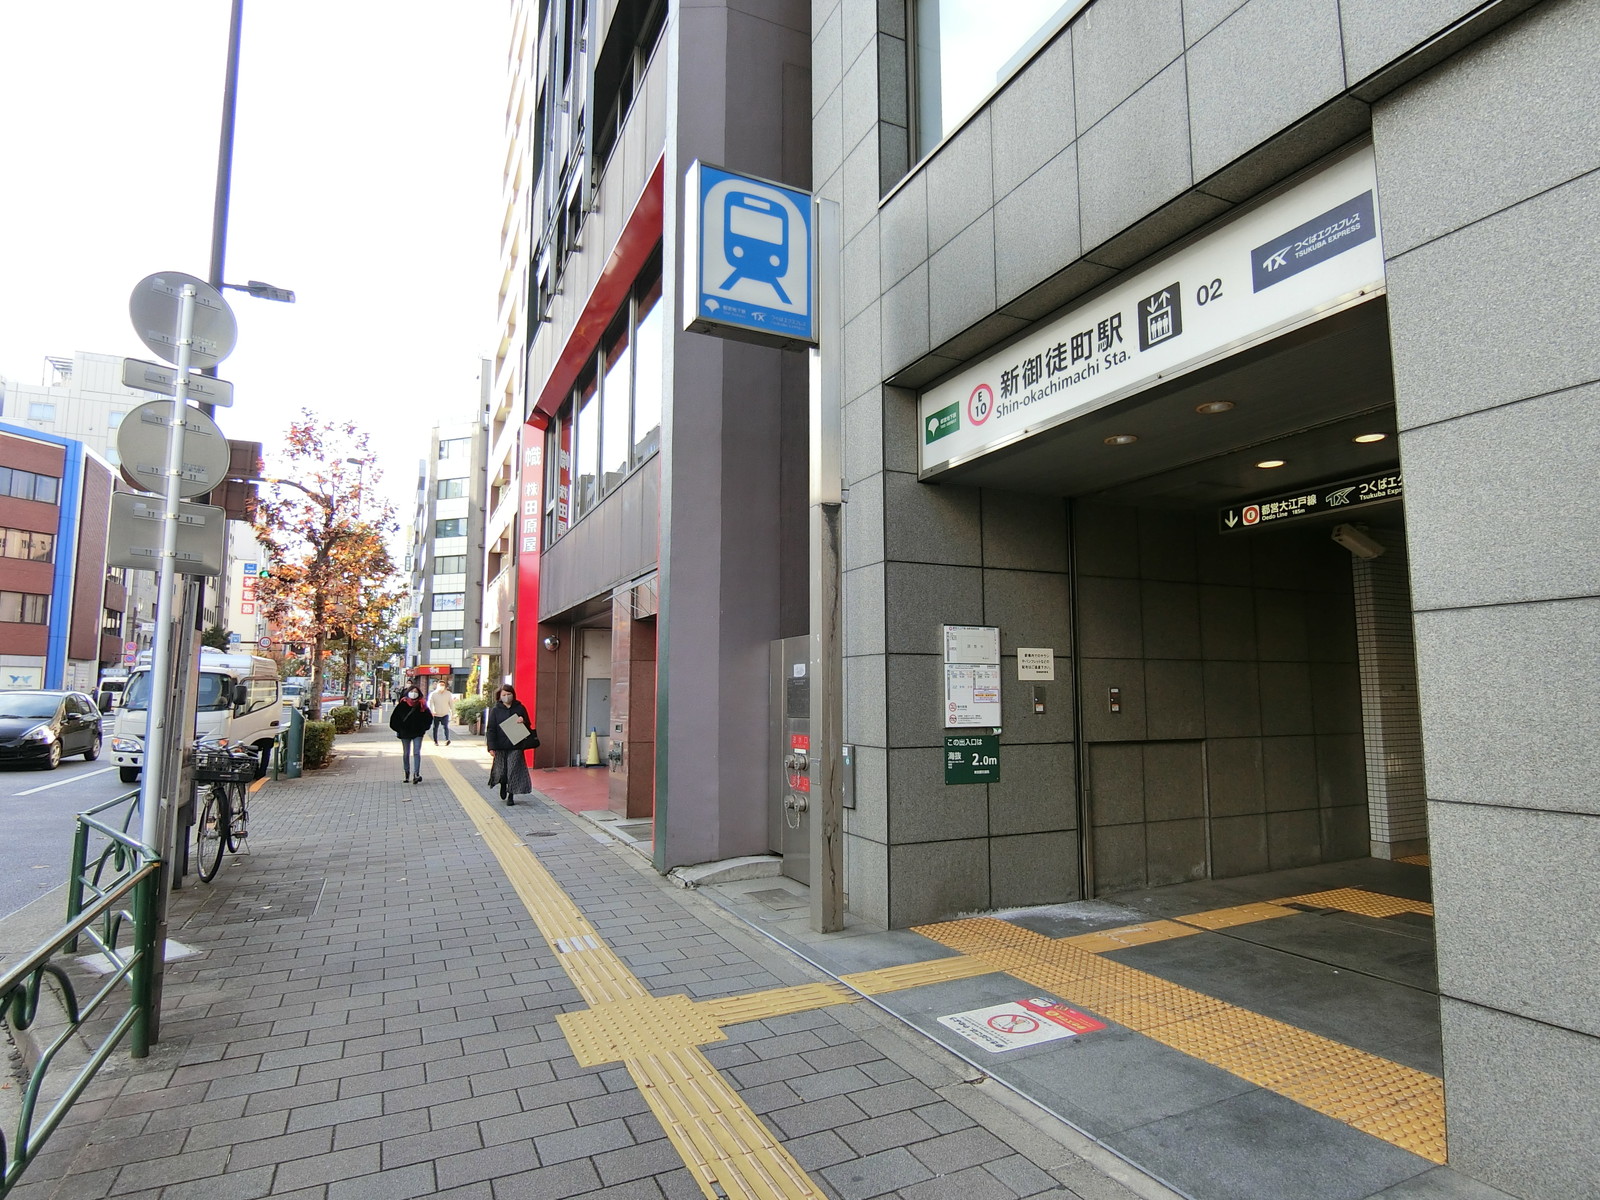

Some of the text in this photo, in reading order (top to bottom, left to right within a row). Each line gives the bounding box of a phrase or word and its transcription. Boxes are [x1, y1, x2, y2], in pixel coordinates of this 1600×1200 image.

[1294, 223, 1361, 259] TSUKUBA EXPRESS
[1295, 212, 1361, 251] つくばエクスプレス
[1262, 245, 1292, 272] TX
[1196, 278, 1223, 307] 02
[1000, 312, 1123, 400] 新御徒町駅
[996, 350, 1131, 419] Shin-okachimachi Sta.
[977, 391, 983, 403] E
[975, 402, 987, 418] 10
[1261, 494, 1317, 514] 都営大江戸線
[1359, 490, 1386, 501] Tsukuba
[1262, 513, 1276, 522] Oedo
[1276, 511, 1288, 519] Line
[947, 738, 982, 746] この出入口は
[971, 753, 998, 766] 2.0m
